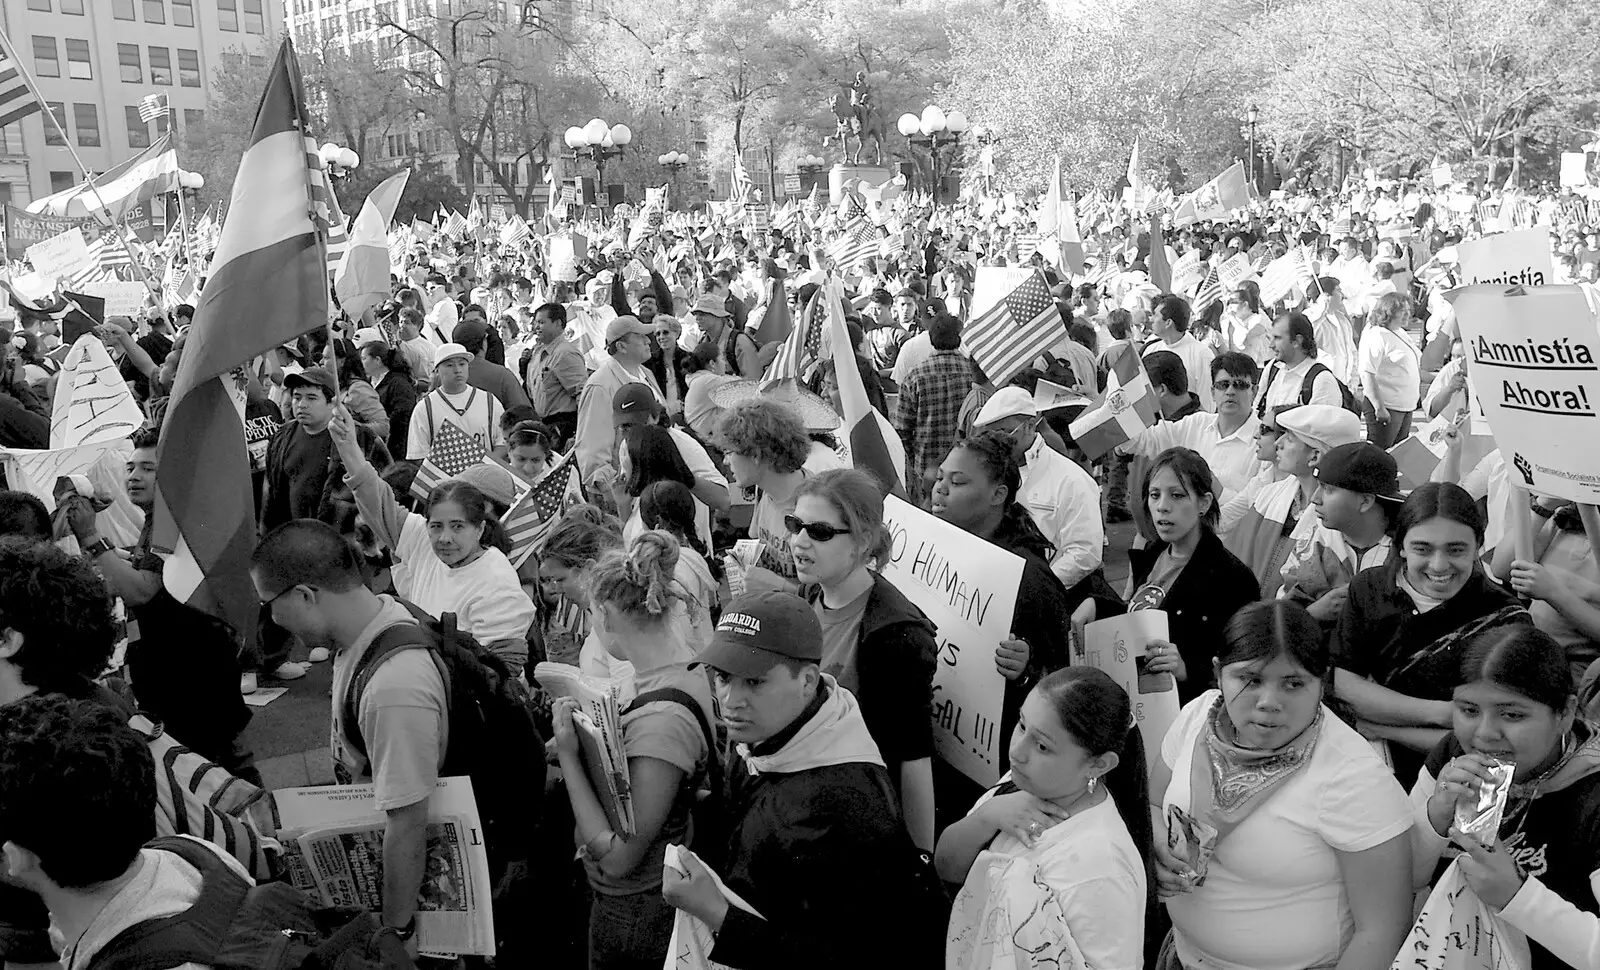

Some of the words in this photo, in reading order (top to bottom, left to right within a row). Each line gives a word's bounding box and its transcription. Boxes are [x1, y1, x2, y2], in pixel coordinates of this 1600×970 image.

[14, 217, 74, 233] AGAINST
[1471, 335, 1594, 363] ¡Amnistía
[1503, 380, 1591, 410] Ahora!
[912, 541, 994, 627] HUMAN
